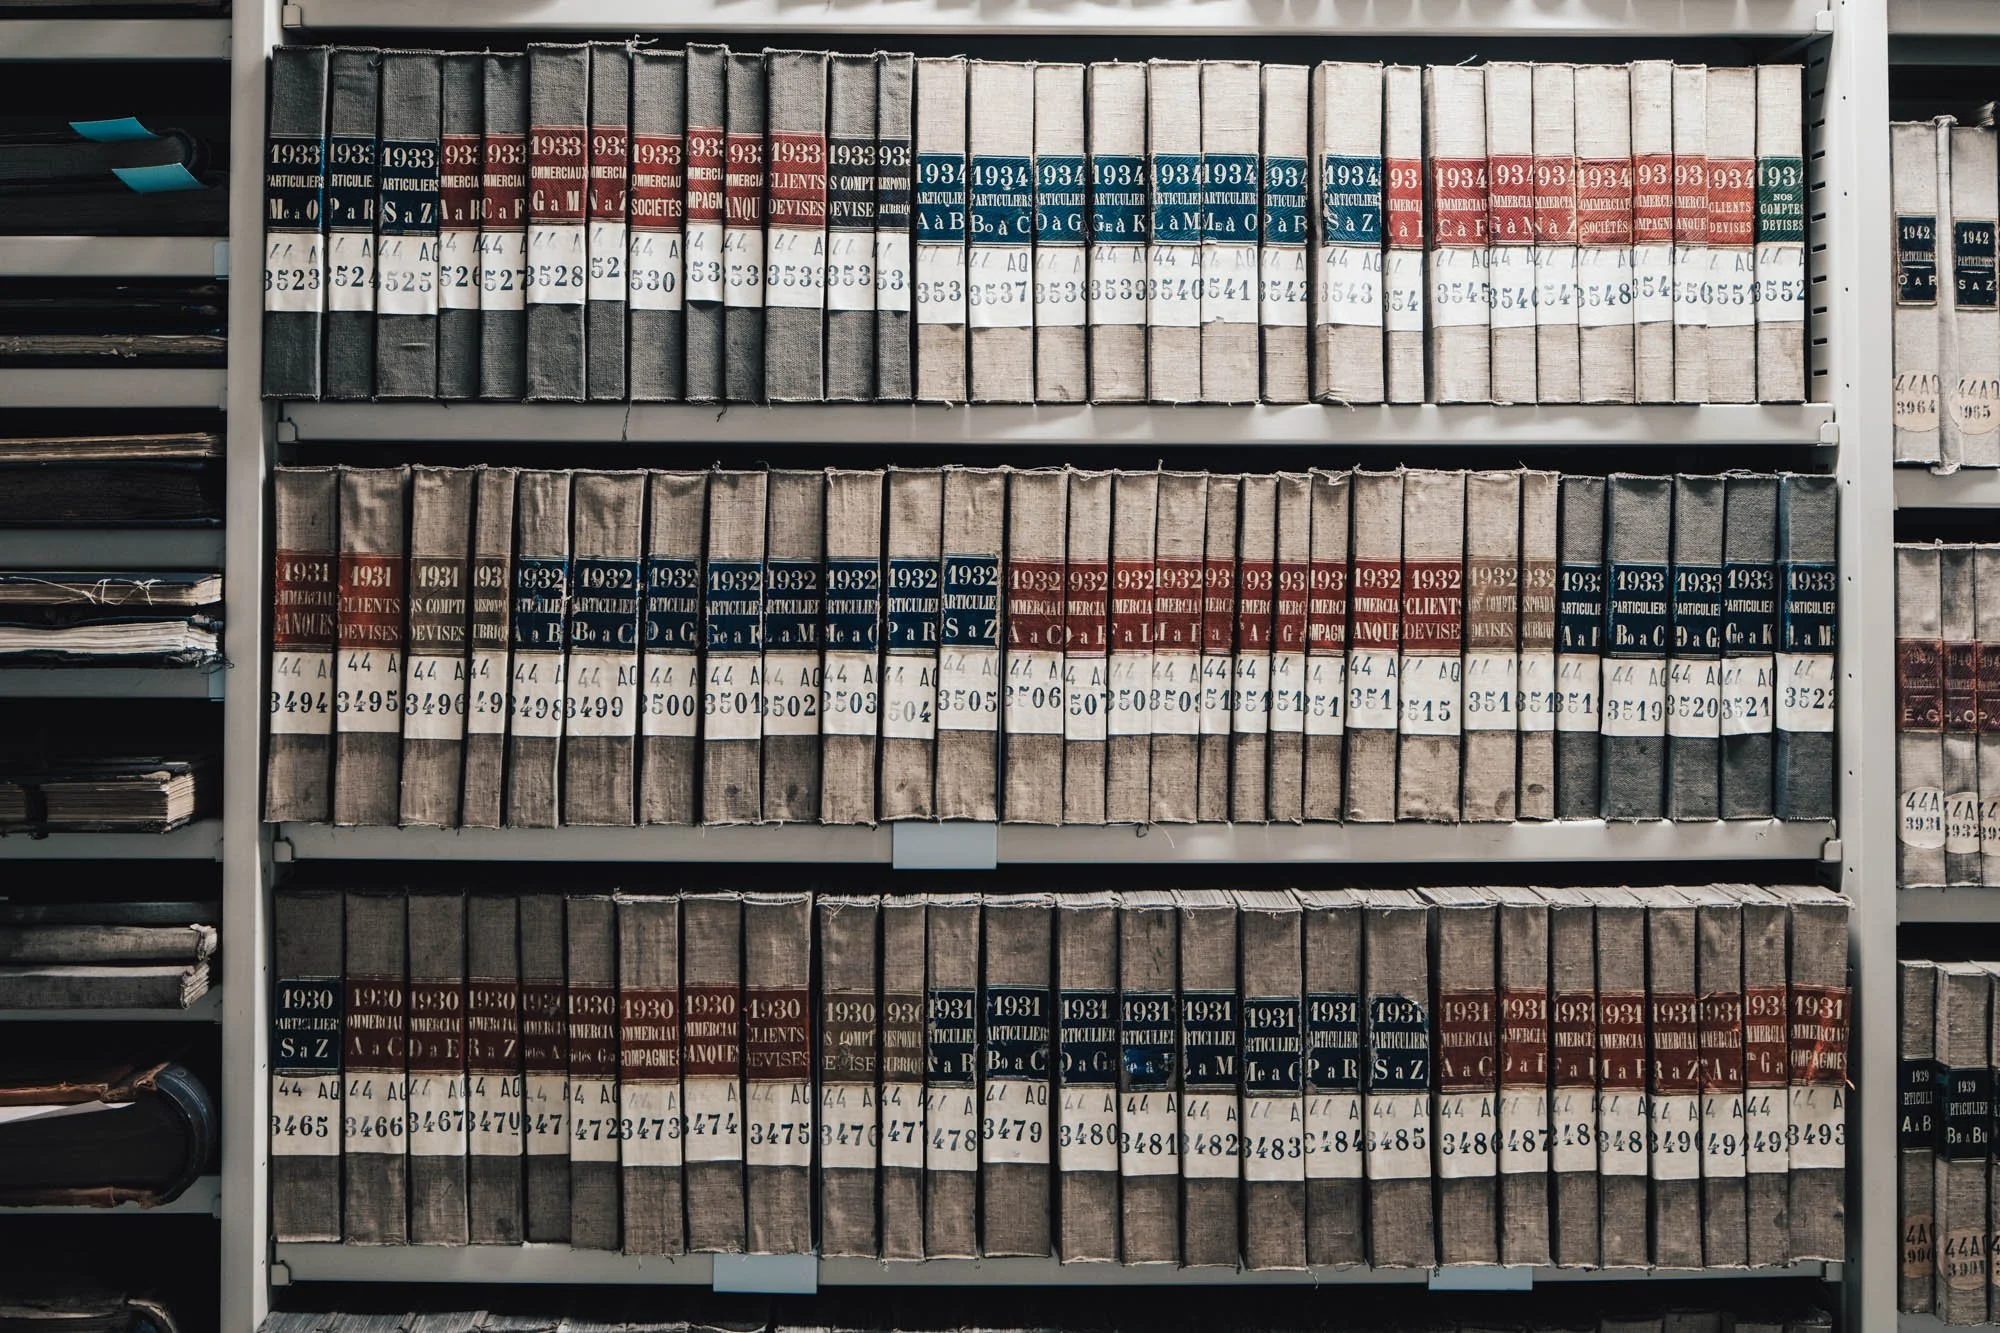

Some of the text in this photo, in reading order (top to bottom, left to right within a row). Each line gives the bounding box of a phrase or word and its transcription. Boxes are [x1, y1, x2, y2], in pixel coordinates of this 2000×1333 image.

[272, 144, 320, 165] 1933
[531, 136, 581, 155] 1933
[634, 145, 680, 164] 1933
[772, 143, 821, 163] 1933
[830, 146, 875, 165] 1933
[383, 148, 434, 168] 1933
[973, 167, 1028, 186] 1934
[1093, 165, 1144, 185] 1934
[1203, 165, 1256, 184] 1934
[1327, 166, 1378, 186] 1934
[1436, 168, 1487, 188] 1934
[1579, 167, 1630, 188] 1934
[533, 190, 579, 211] G a M
[632, 198, 681, 216] SOCIÉTÉS
[1709, 202, 1750, 213] CLIENTS
[386, 201, 432, 223] S a Z
[1328, 214, 1373, 231] S à Z
[1710, 222, 1751, 232] DEVISES
[1763, 220, 1803, 231] DEVISES
[1904, 226, 1930, 239] 1942
[1963, 232, 1989, 244] 1942
[1008, 253, 1027, 272] AQ
[264, 269, 320, 290] 3523
[527, 266, 583, 286] 3528
[1959, 280, 1965, 289] S
[1986, 281, 1993, 290] Z
[970, 281, 1027, 305] 3537
[1092, 279, 1145, 299] 3539
[1322, 282, 1372, 303] 3543
[1438, 283, 1489, 303] 3545
[1897, 402, 1935, 414] 3964
[282, 563, 329, 582] 1931
[351, 566, 391, 587] 1931
[419, 566, 458, 587] 1931
[519, 569, 563, 588] 1932
[581, 569, 631, 588] 1932
[651, 568, 696, 587] 1932
[711, 571, 760, 590] 1932
[768, 570, 817, 590] 1932
[828, 570, 877, 589] 1932
[888, 569, 937, 588] 1932
[949, 566, 997, 585] 1932
[1011, 570, 1060, 590] 1932
[1157, 569, 1200, 588] 1932
[1355, 568, 1400, 588] 1932
[1413, 570, 1460, 589] 1932
[1472, 568, 1517, 586] 1932
[1618, 571, 1664, 591] 1933
[1678, 573, 1721, 592] 1933
[1728, 570, 1773, 589] 1933
[1791, 571, 1835, 591] 1933
[339, 599, 399, 613] CLIENTS
[339, 626, 398, 640] DEVISES
[576, 623, 633, 643] Bo a C
[946, 619, 996, 638] S a Z
[1009, 624, 1061, 644] A a C
[1473, 624, 1513, 636] DEVISES
[1616, 625, 1664, 646] Bo a C
[1726, 623, 1772, 645] Ge a K
[279, 658, 301, 676] 44
[414, 661, 435, 680] 44
[271, 692, 327, 713] 3494
[337, 690, 397, 712] 3495
[406, 694, 464, 714] 3496
[567, 697, 623, 717] 3499
[705, 693, 760, 714] 3501
[763, 695, 815, 716] 3502
[823, 692, 876, 713] 3503
[939, 690, 996, 712] 3505
[1667, 695, 1718, 717] 3520
[1722, 697, 1770, 719] 3521
[1785, 687, 1834, 709] 3522
[1608, 699, 1662, 721] 3519
[1904, 709, 1914, 720] E
[1927, 710, 1939, 721] G
[1906, 816, 1940, 831] 3931
[283, 989, 333, 1009] 1930
[355, 988, 401, 1007] 1930
[412, 991, 459, 1010] 1930
[469, 990, 515, 1010] 1930
[687, 995, 734, 1014] 1930
[995, 997, 1040, 1016] 1931
[1795, 996, 1842, 1019] 1931
[624, 999, 673, 1019] 1930
[750, 999, 800, 1018] 1930
[826, 1003, 874, 1022] 1930
[929, 999, 973, 1018] 1931
[1064, 1000, 1108, 1019] 1931
[1124, 1002, 1169, 1021] 1931
[1184, 1002, 1231, 1022] 1931
[1250, 1008, 1294, 1028] 1931
[1311, 1002, 1356, 1022] 1931
[1377, 1003, 1421, 1023] 1931
[1444, 1003, 1489, 1022] 1931
[1504, 1000, 1547, 1019] 1931
[1654, 1004, 1696, 1023] 1931
[281, 1039, 328, 1057] S a Z
[989, 1051, 1045, 1070] Bo a C
[1376, 1060, 1423, 1080] S a Z
[1442, 1056, 1492, 1077] A a C
[1912, 1071, 1929, 1082] 1939
[279, 1081, 340, 1099] 44 AQ
[1958, 1082, 1975, 1092] 1939
[273, 1115, 328, 1137] 3465
[346, 1116, 403, 1137] 3466
[409, 1111, 464, 1133] 3467
[621, 1118, 679, 1140] 3473
[984, 1118, 1041, 1143] 3479
[1903, 1117, 1911, 1131] A
[1924, 1116, 1931, 1131] B
[751, 1123, 809, 1144] 3475
[1060, 1123, 1116, 1146] 3480
[1122, 1132, 1176, 1155] 3481
[1367, 1128, 1425, 1151] 3485
[1789, 1124, 1845, 1145] 3493
[1973, 1128, 1987, 1143] Bu
